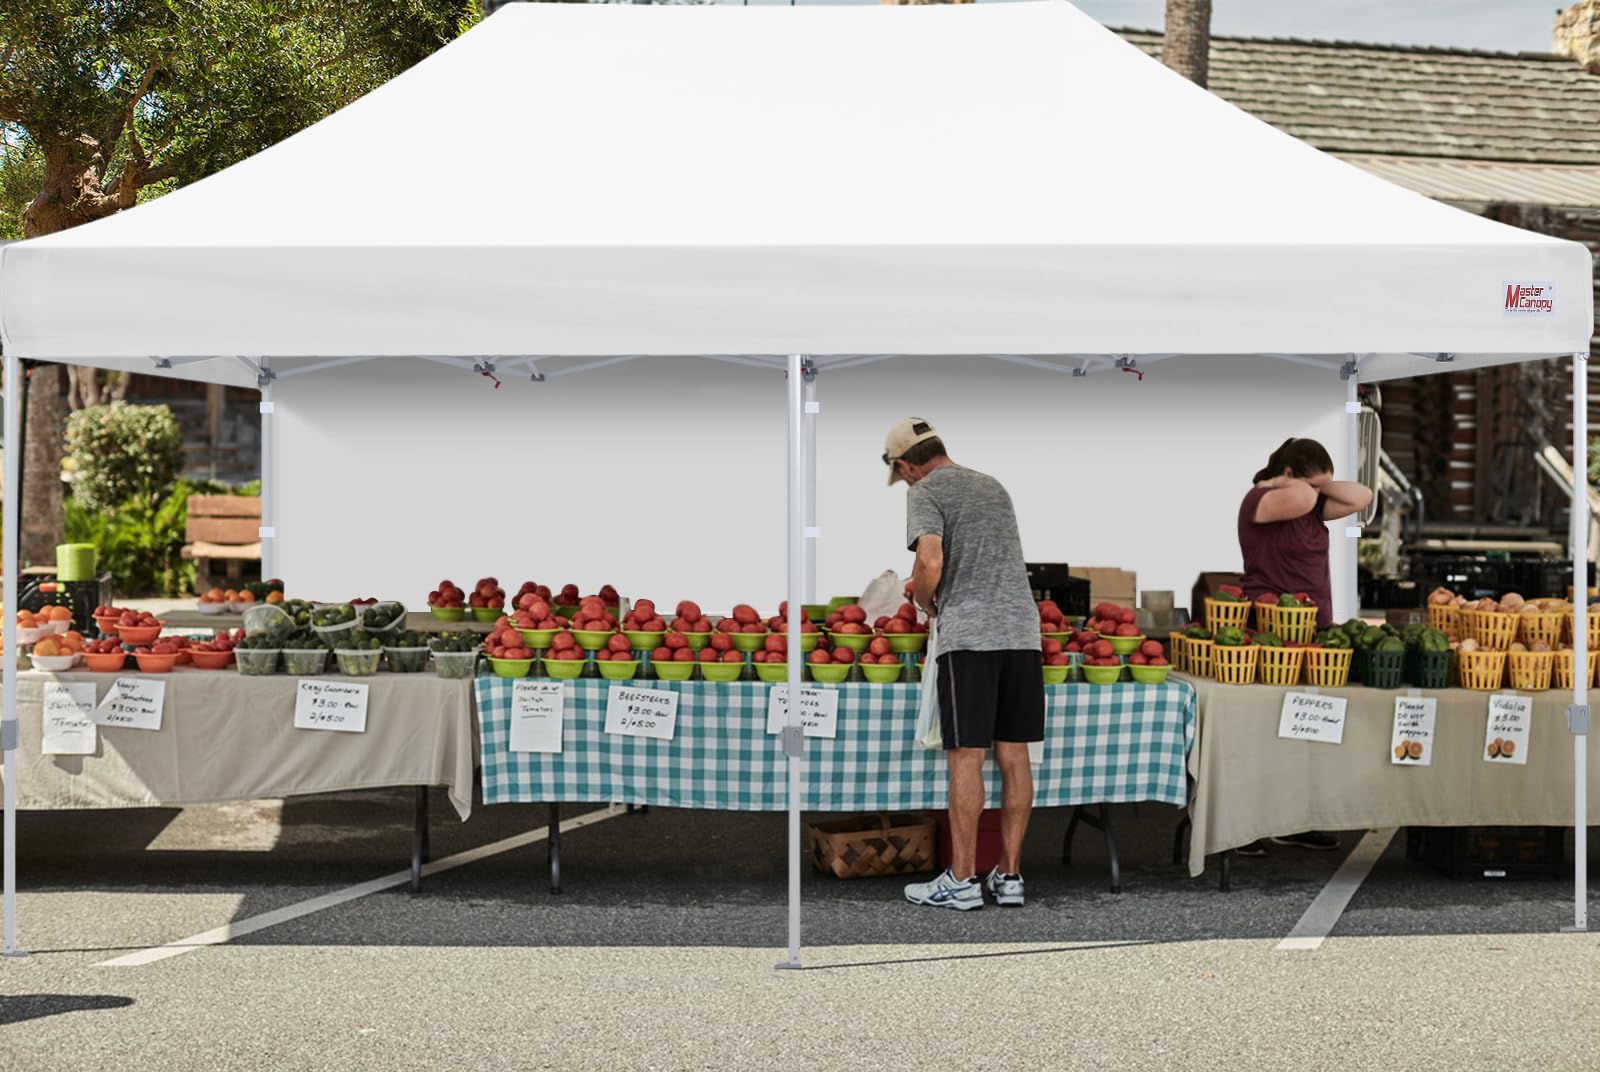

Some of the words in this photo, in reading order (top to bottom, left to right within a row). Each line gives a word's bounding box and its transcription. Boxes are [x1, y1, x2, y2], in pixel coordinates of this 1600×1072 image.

[1505, 284, 1544, 308] Master
[1519, 296, 1552, 312] Canopy
[1493, 699, 1526, 712] Vidalia
